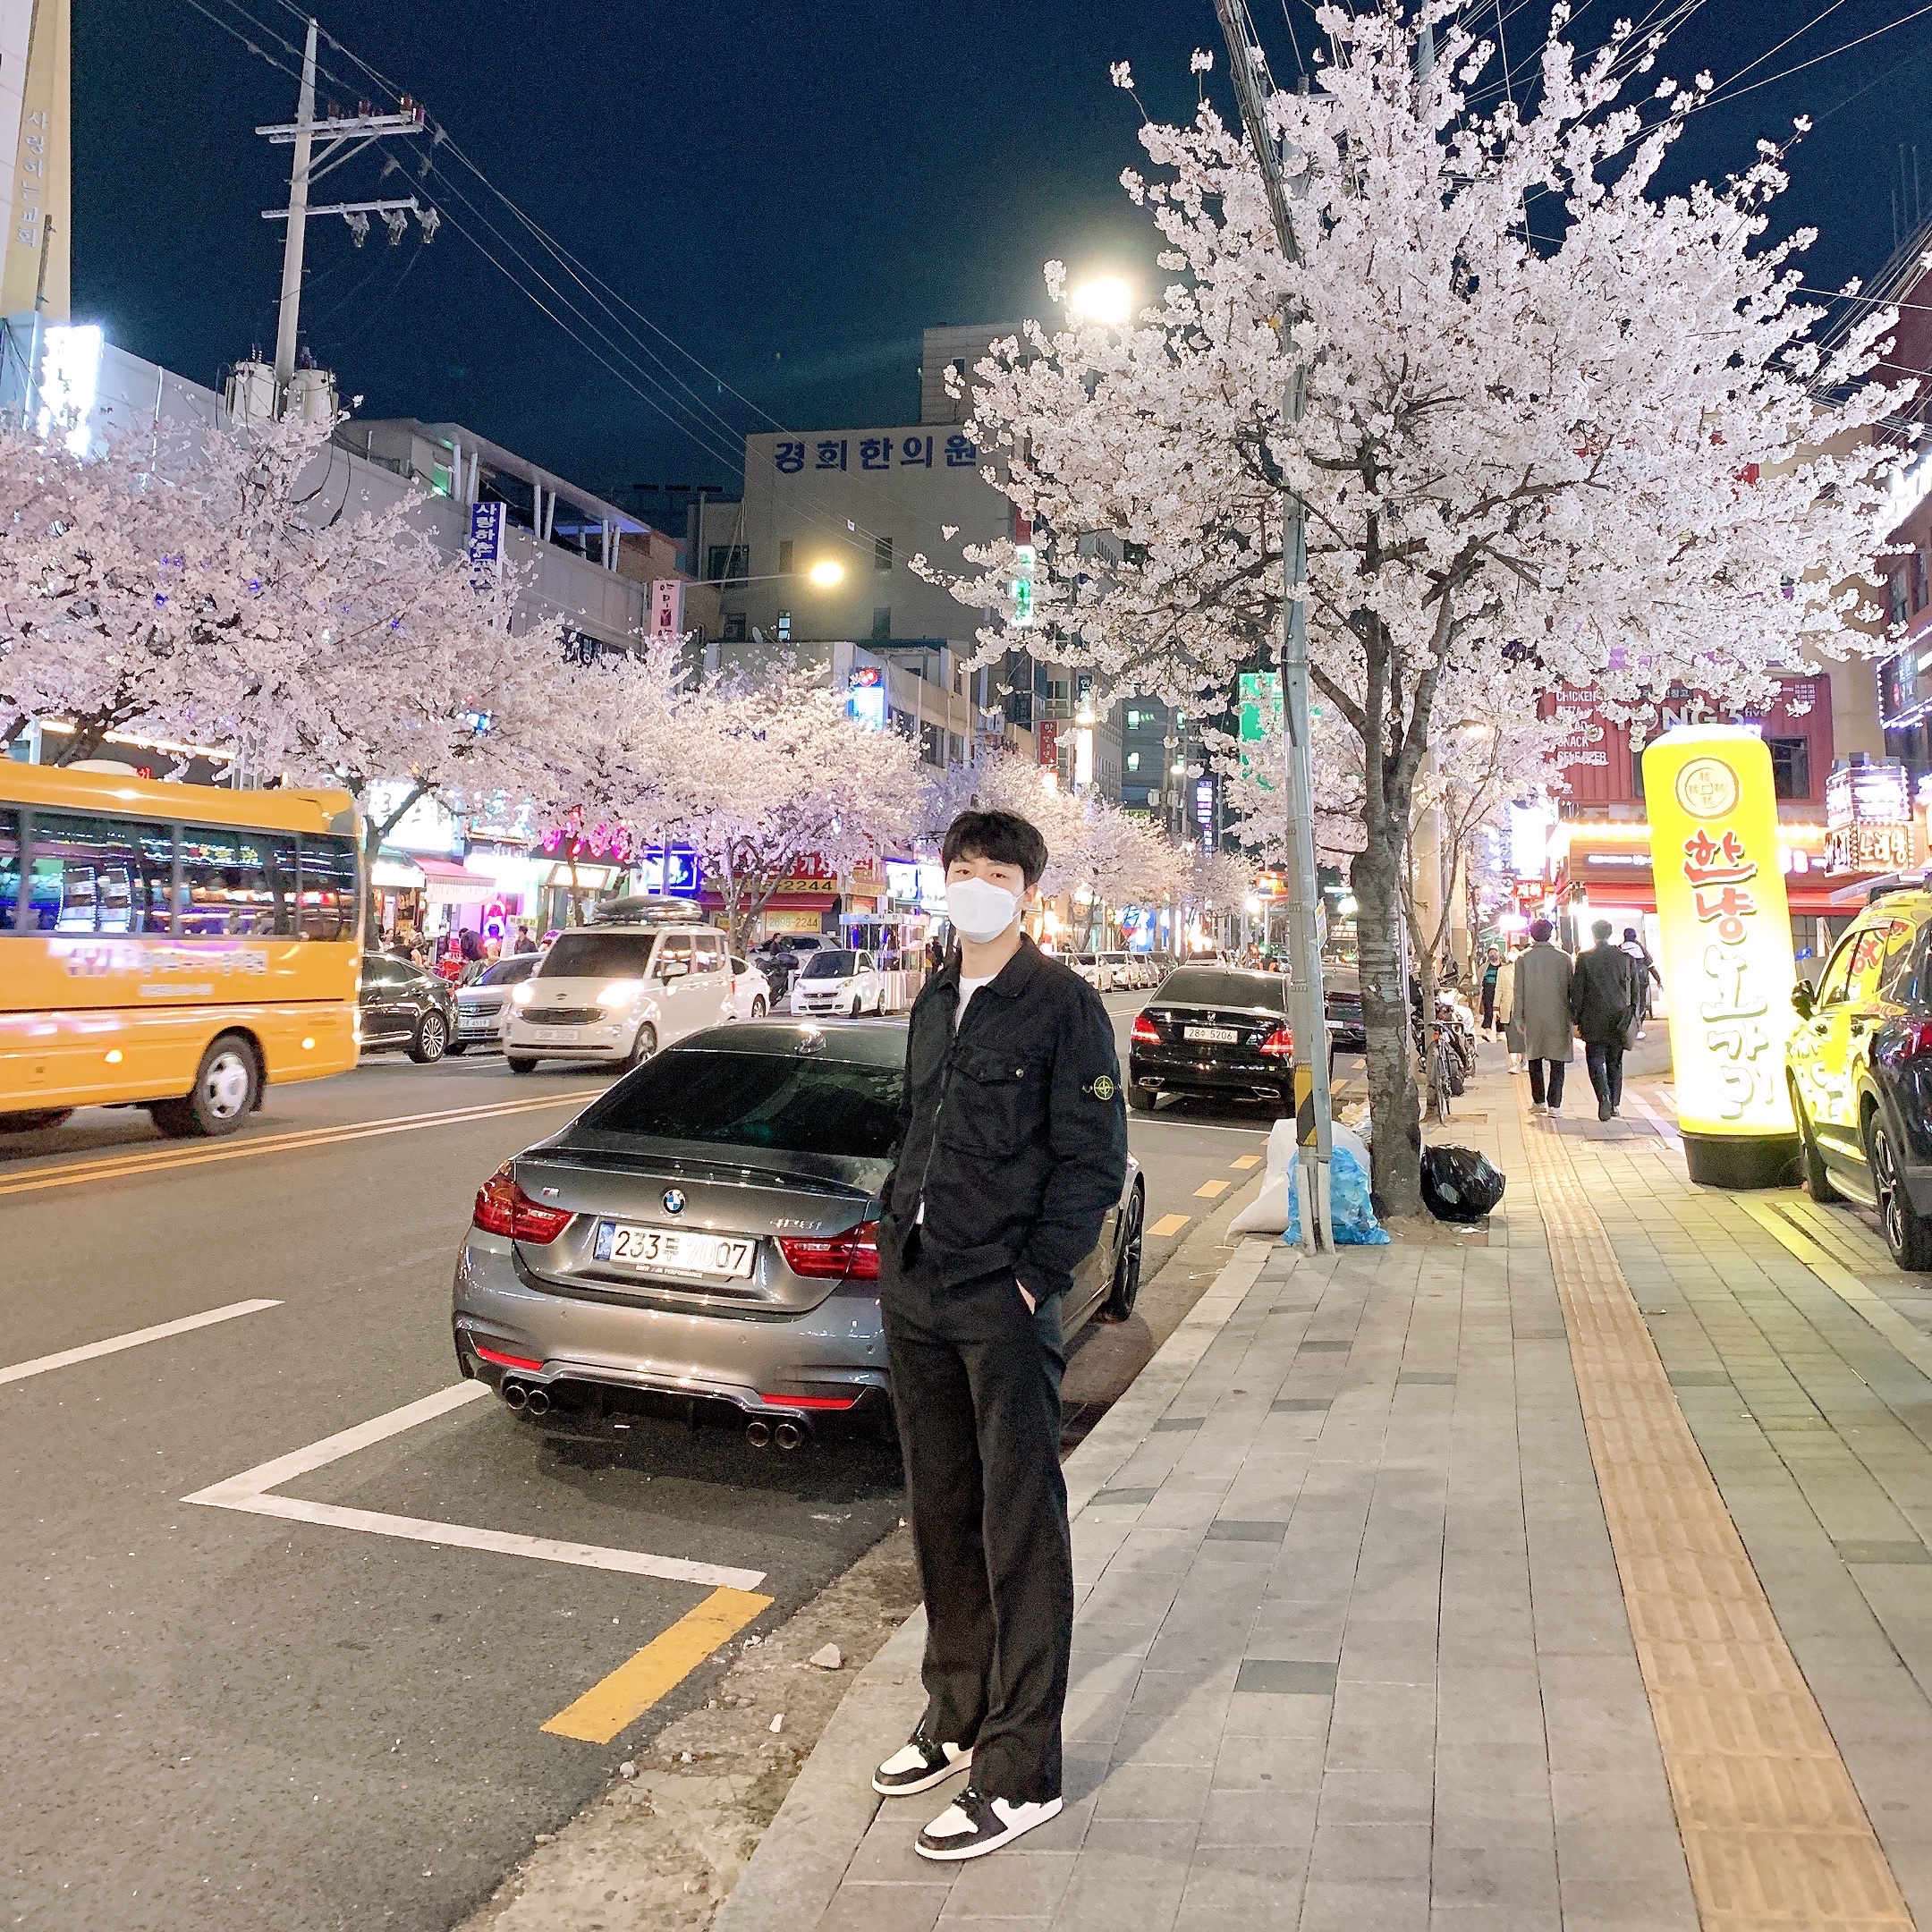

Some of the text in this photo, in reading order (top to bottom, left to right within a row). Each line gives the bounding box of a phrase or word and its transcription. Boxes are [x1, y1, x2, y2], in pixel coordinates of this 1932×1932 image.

[775, 435, 977, 474] 경희한의원
[769, 917, 818, 928] 2698-2244
[1210, 1030, 1233, 1040] 5206
